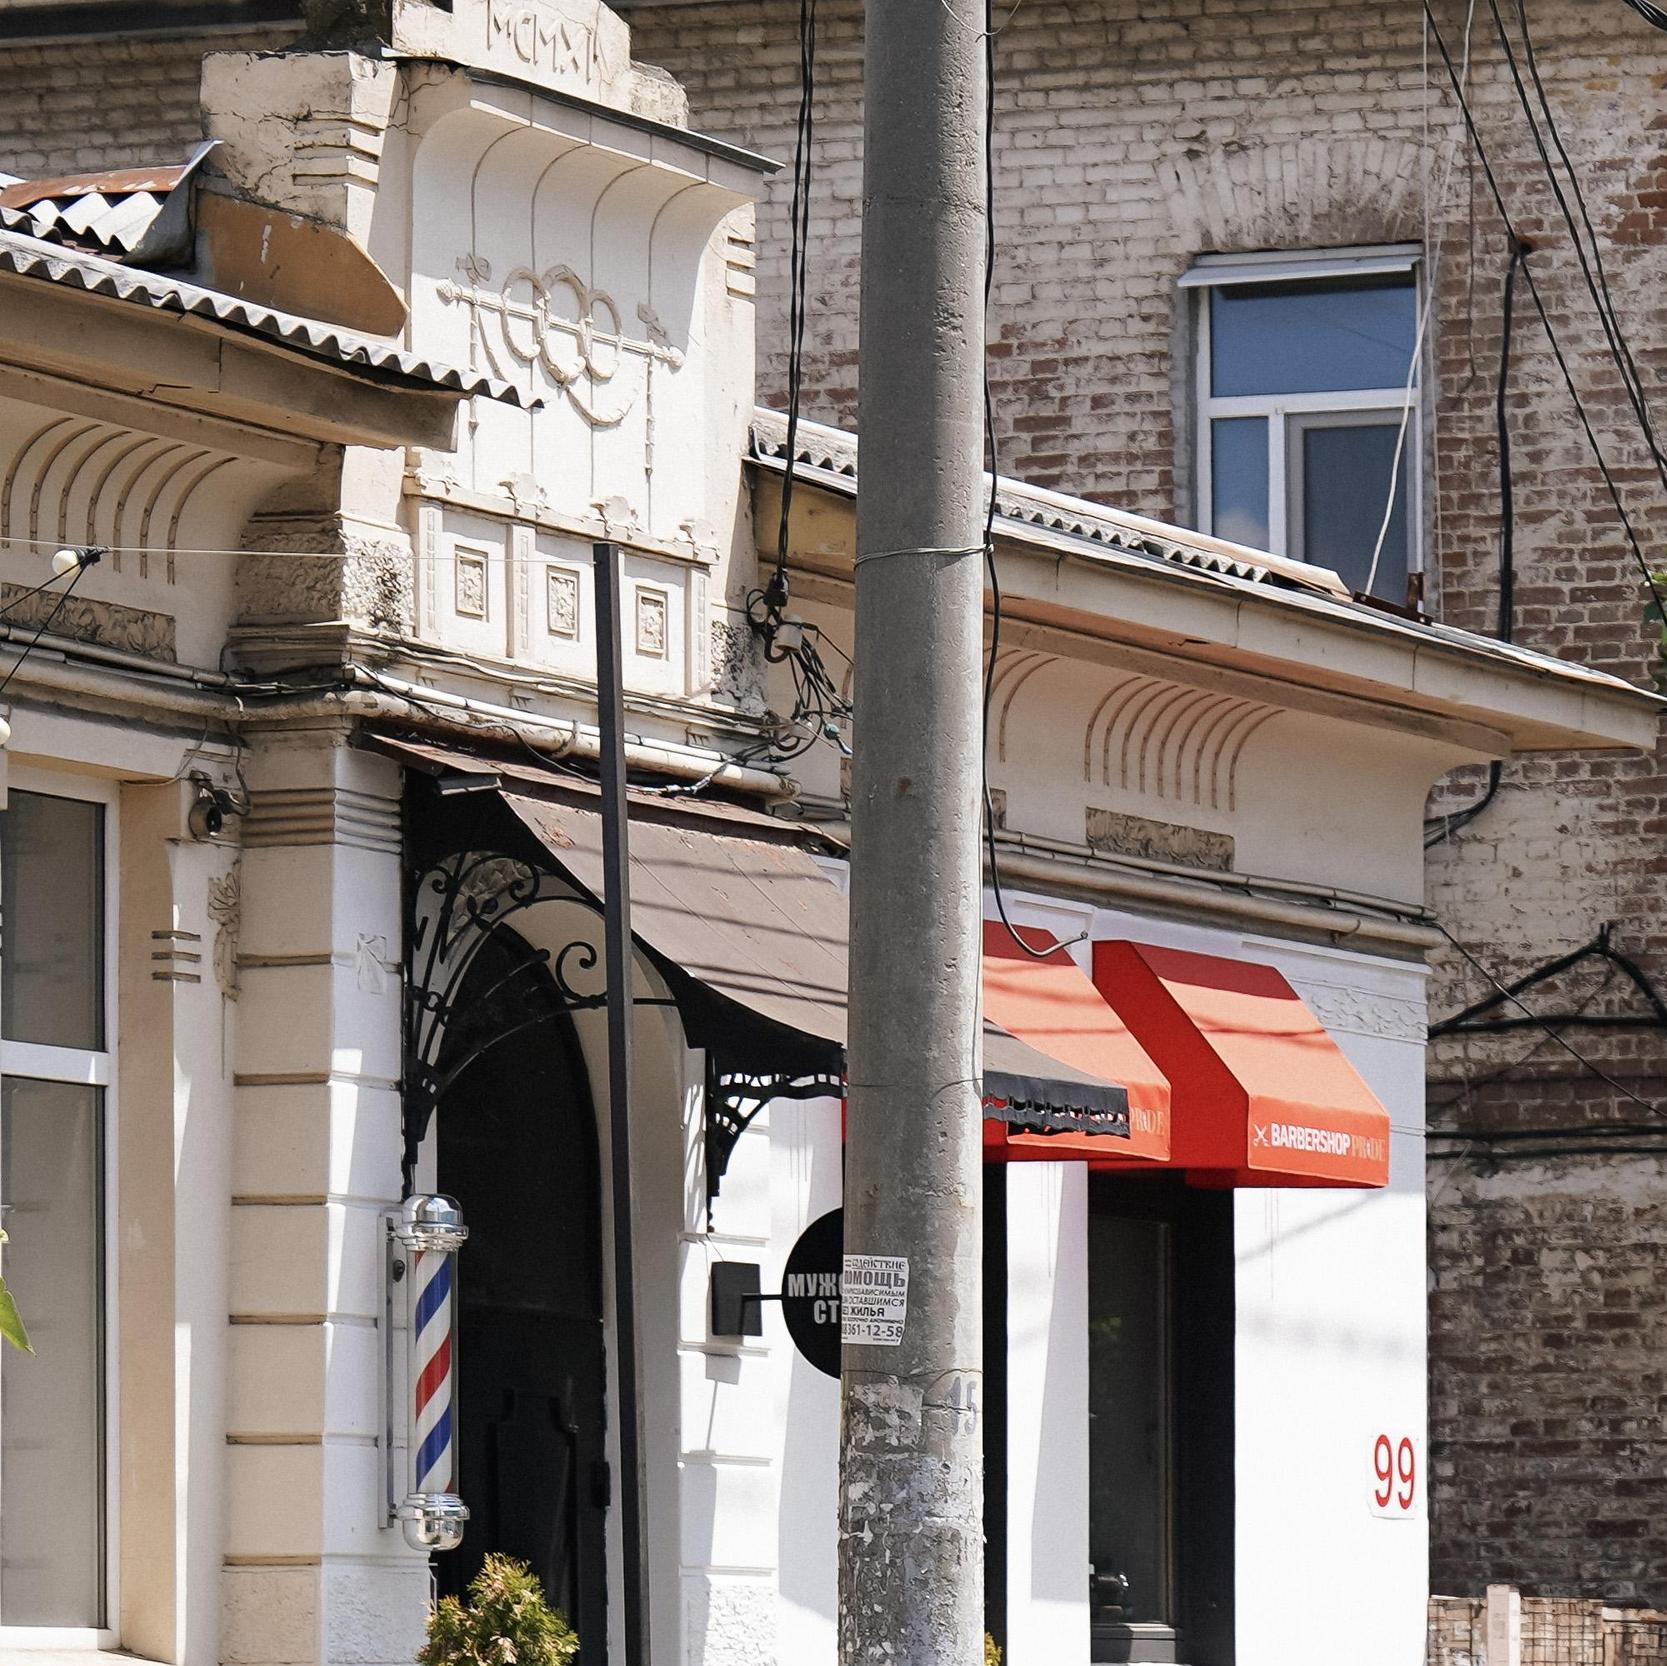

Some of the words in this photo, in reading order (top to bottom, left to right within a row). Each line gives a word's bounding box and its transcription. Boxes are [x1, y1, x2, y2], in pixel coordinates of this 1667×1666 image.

[1271, 1122, 1351, 1156] BARBERSHOP
[1351, 1134, 1385, 1161] PRIDE
[788, 1273, 844, 1298] МУЖ
[1374, 1434, 1415, 1510] 99
